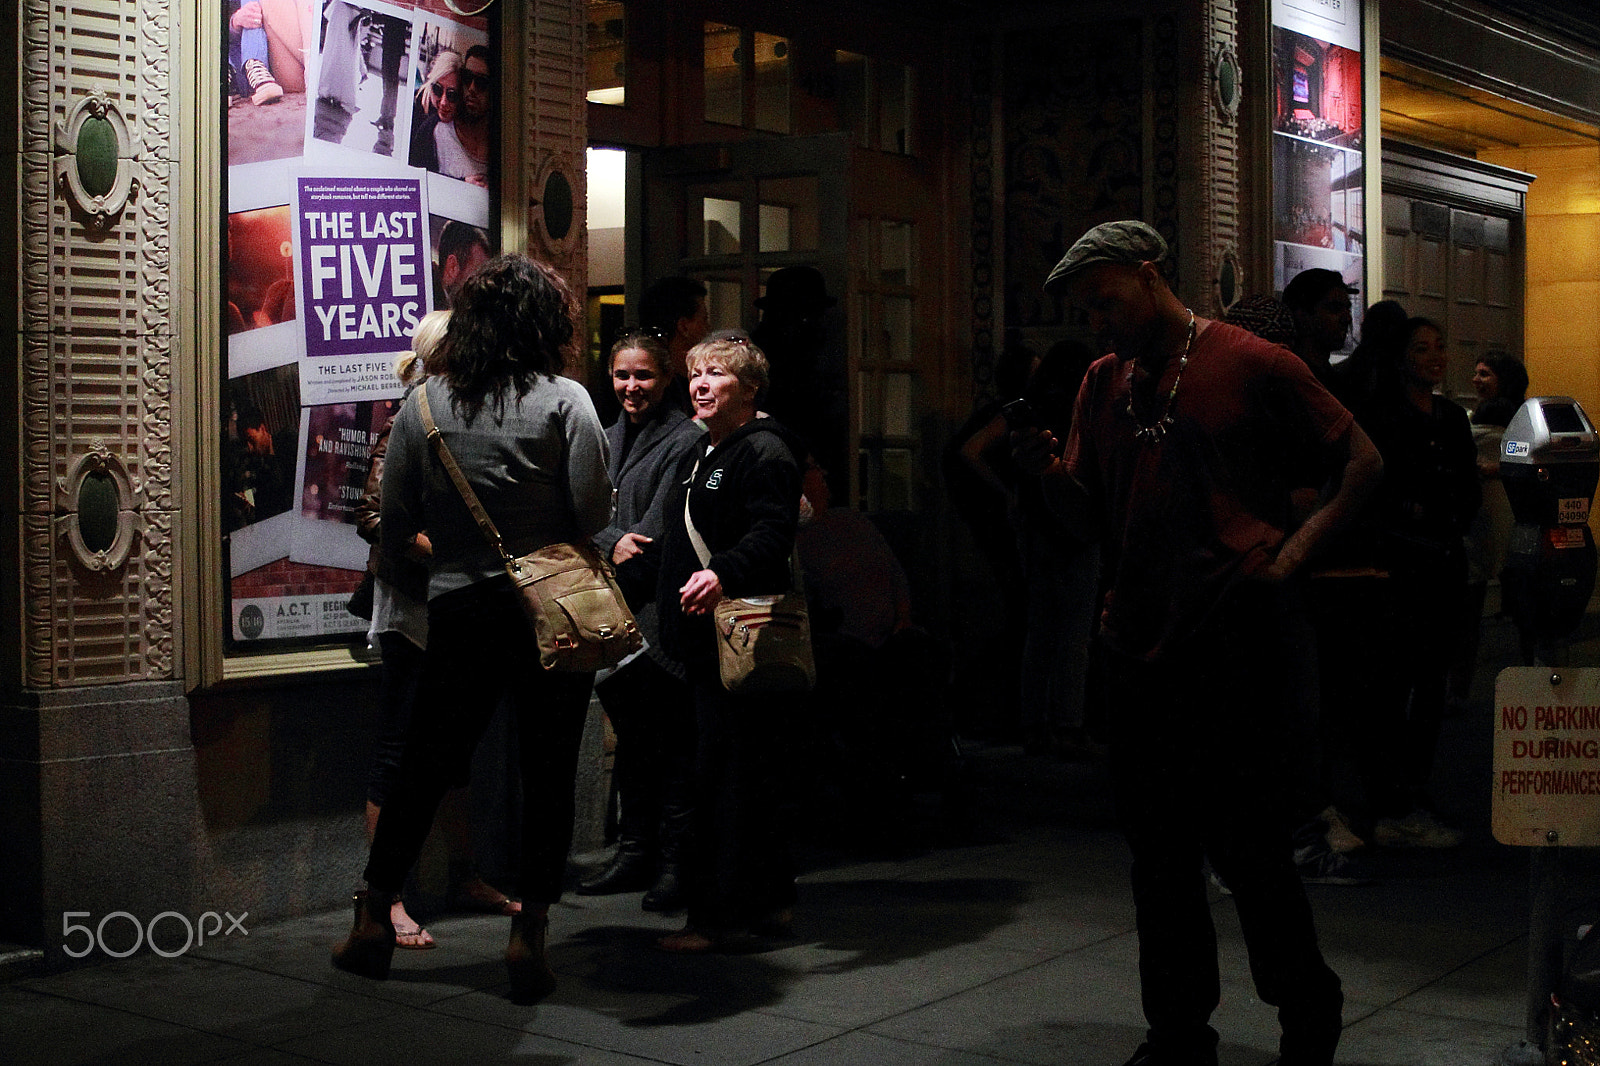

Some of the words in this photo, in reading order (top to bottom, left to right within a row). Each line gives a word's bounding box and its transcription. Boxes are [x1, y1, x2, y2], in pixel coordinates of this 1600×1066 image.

[305, 212, 354, 239] THE
[360, 211, 417, 239] LAST
[310, 244, 418, 299] FIVE
[314, 301, 420, 341] YEARS
[318, 365, 336, 375] THE
[340, 364, 362, 374] LAST
[366, 362, 386, 372] FIVE
[380, 382, 402, 390] BERRE
[318, 439, 333, 453] AND
[334, 441, 372, 460] RAVISHING
[1564, 500, 1582, 510] 440
[1559, 511, 1587, 521] 04090
[277, 602, 311, 617] A.C.T.
[1502, 705, 1528, 731] NO
[1512, 740, 1599, 760] DURING
